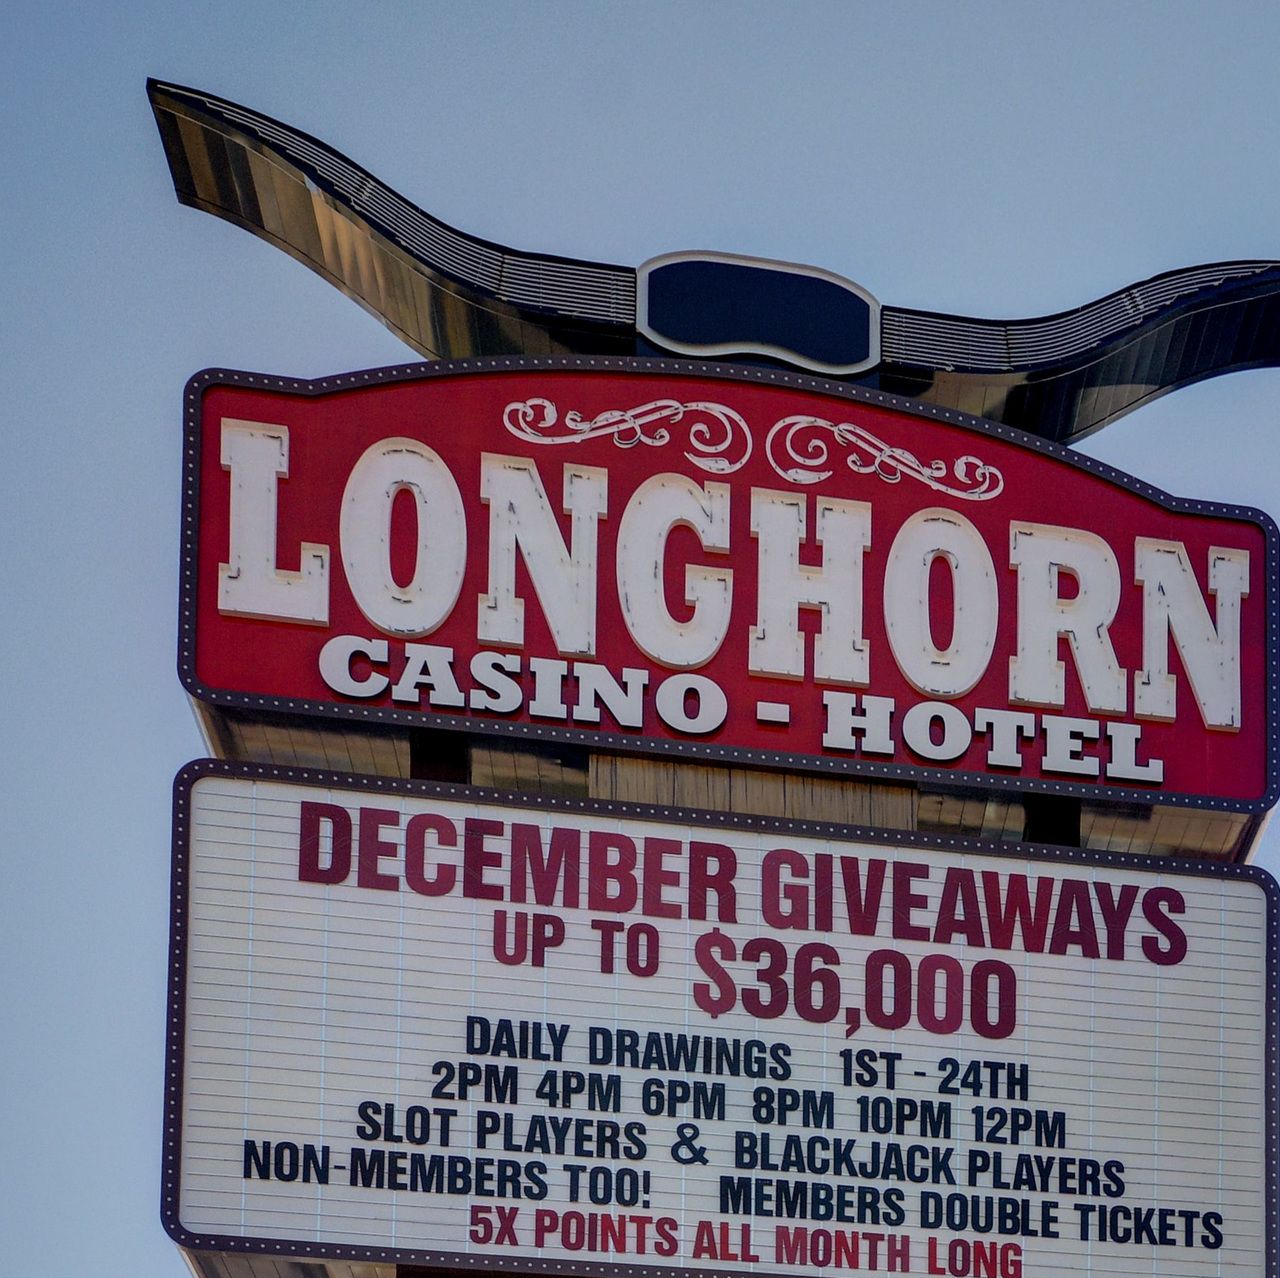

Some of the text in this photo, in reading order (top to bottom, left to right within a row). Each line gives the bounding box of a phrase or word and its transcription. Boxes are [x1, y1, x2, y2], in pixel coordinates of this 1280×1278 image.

[217, 418, 1251, 732] LONGHORN
[318, 635, 728, 735] CASINO
[822, 691, 1165, 783] HOTEL
[299, 800, 1188, 966] DECEMBER GIVEAWAYS
[493, 909, 1017, 1040] UP TO $36,000
[432, 1061, 1066, 1149] 2PM 4PM 6PM 8PM 10PM 12PM
[466, 1015, 570, 1062] DAILY
[589, 1026, 791, 1081] DRAWINGS
[839, 1048, 902, 1090] 1ST
[938, 1057, 1029, 1101] 24TH
[243, 1139, 1224, 1249] NON-MEMBERS TOO! MEMBERS DOUBLE TICKETS
[356, 1101, 1125, 1198] SLOT PLAYERS & BLACKJACK PLAYERS
[469, 1205, 520, 1247] 5X
[535, 1209, 679, 1257] POINTS
[692, 1220, 760, 1263] ALL
[775, 1226, 910, 1273] MONTH
